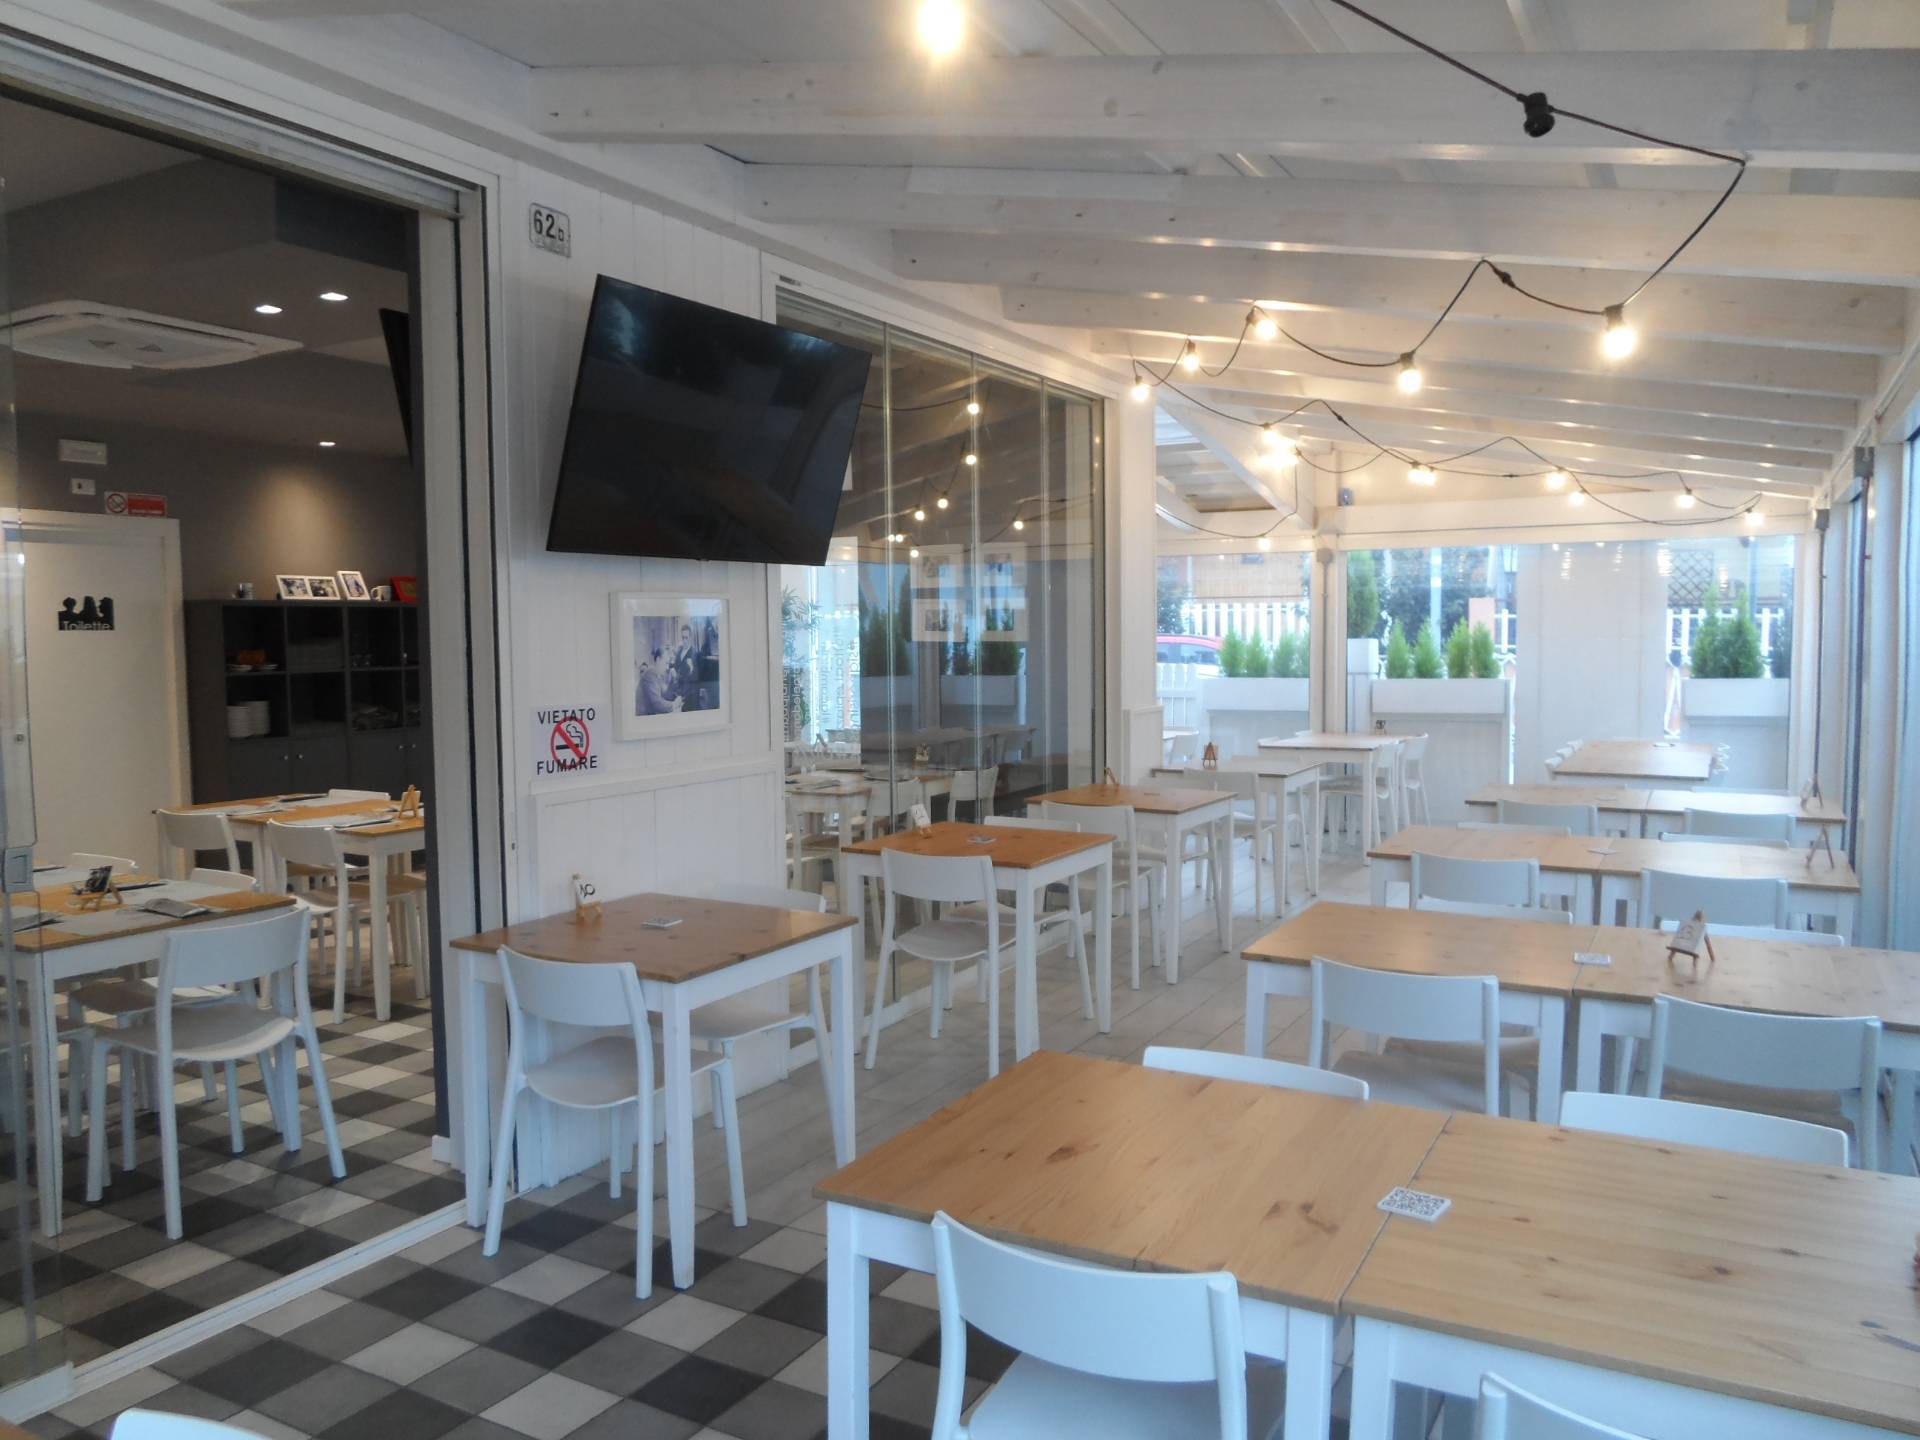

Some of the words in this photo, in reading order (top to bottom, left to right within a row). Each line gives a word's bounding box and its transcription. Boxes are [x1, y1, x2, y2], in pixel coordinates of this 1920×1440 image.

[63, 620, 112, 631] Toilette
[537, 707, 596, 725] VIETATO
[536, 755, 598, 775] FUMARE
